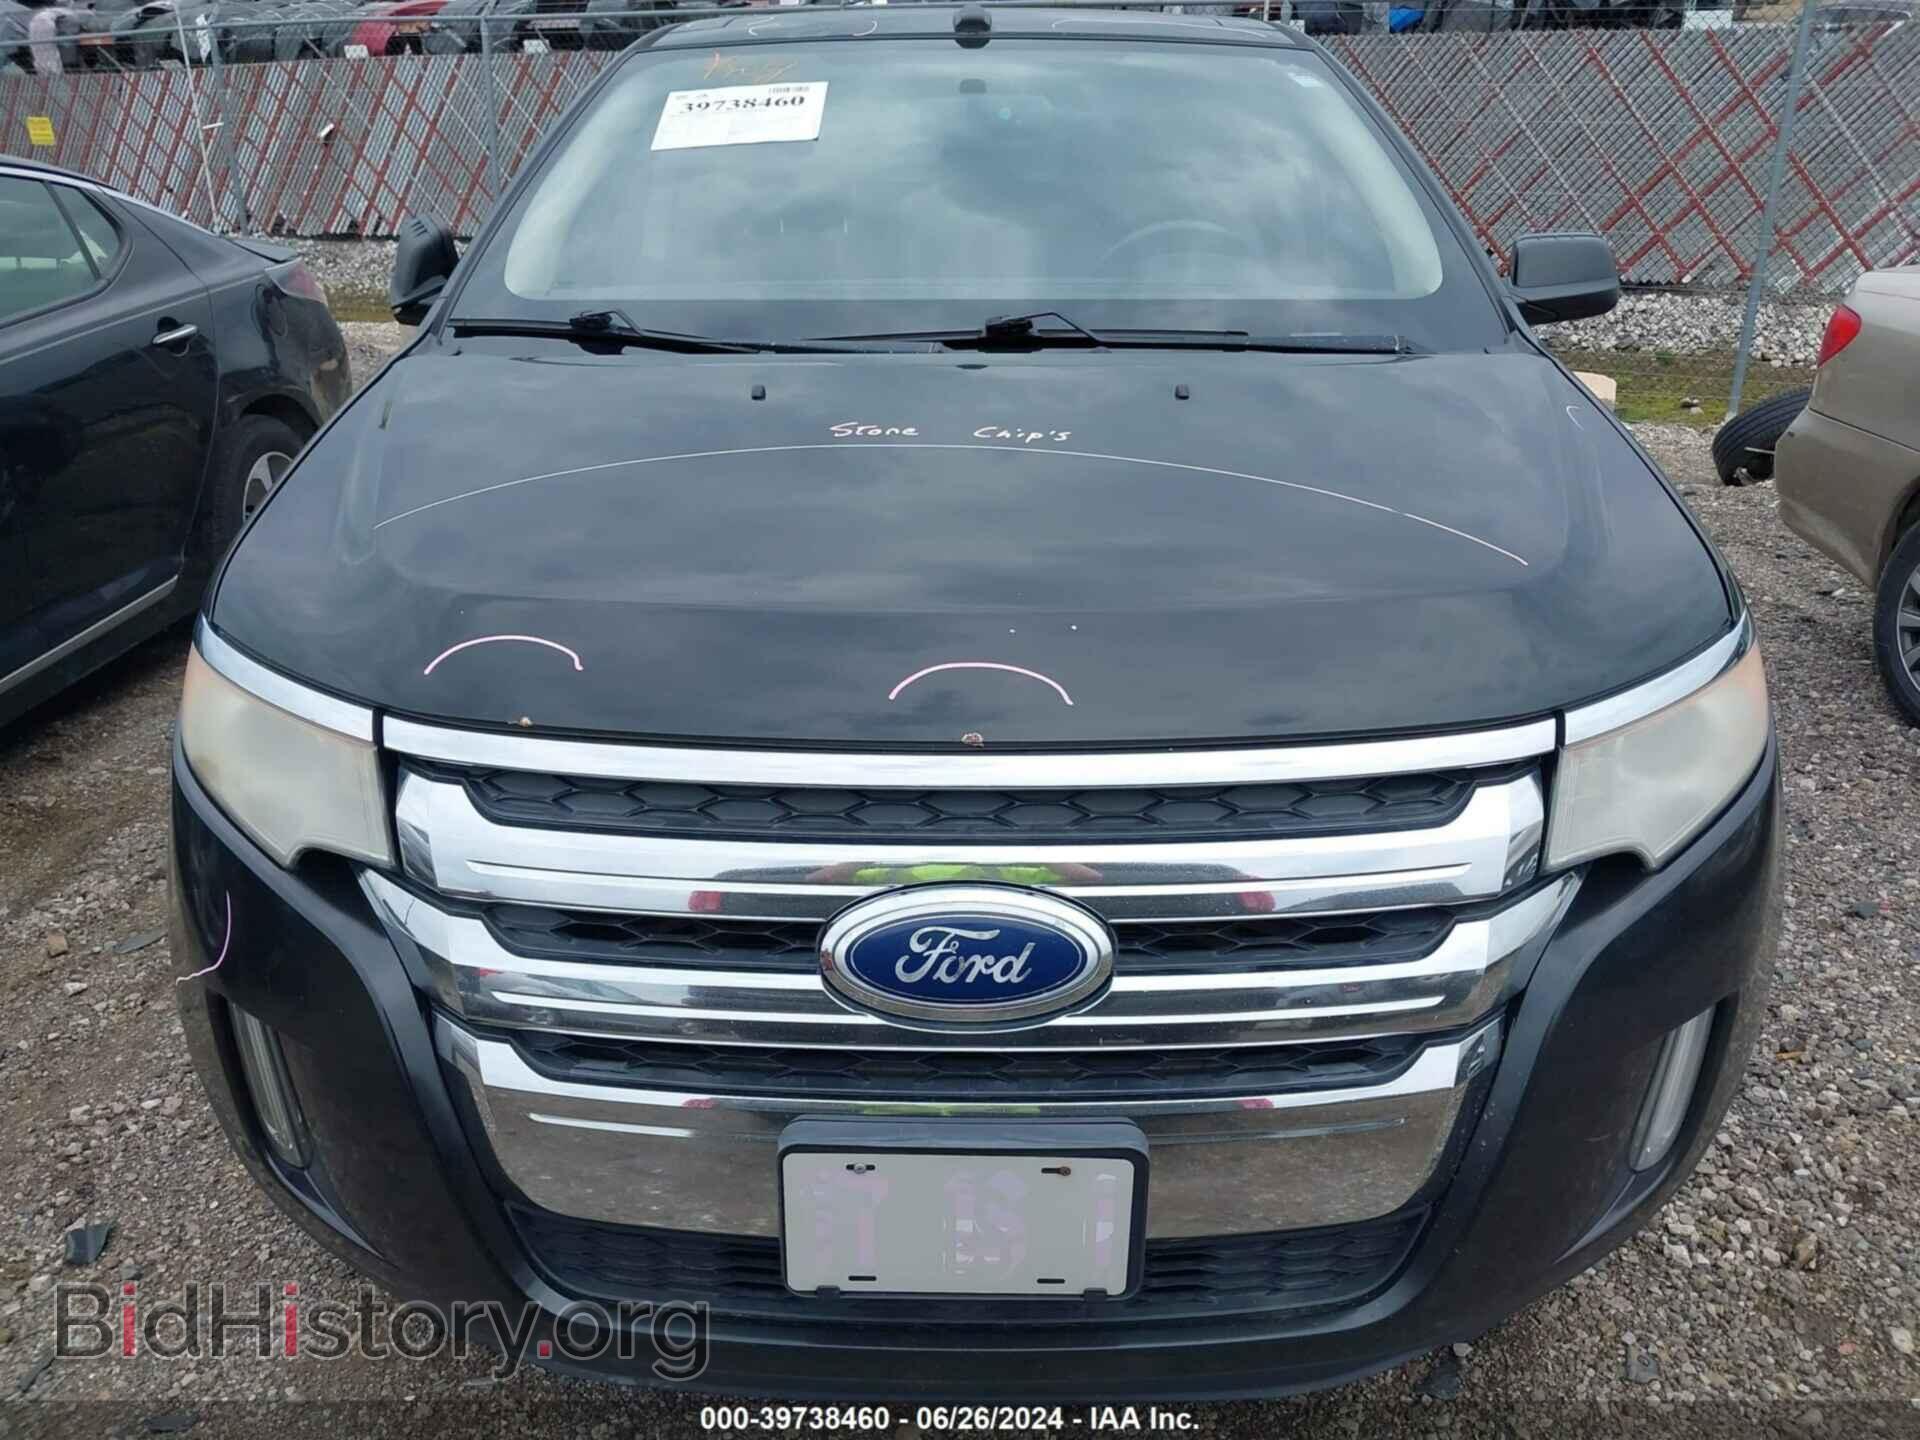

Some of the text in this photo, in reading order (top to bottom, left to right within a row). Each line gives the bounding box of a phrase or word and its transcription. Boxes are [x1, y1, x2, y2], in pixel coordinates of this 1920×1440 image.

[679, 95, 806, 114] 39738460
[829, 421, 919, 438] Stone
[895, 926, 1037, 984] Ford
